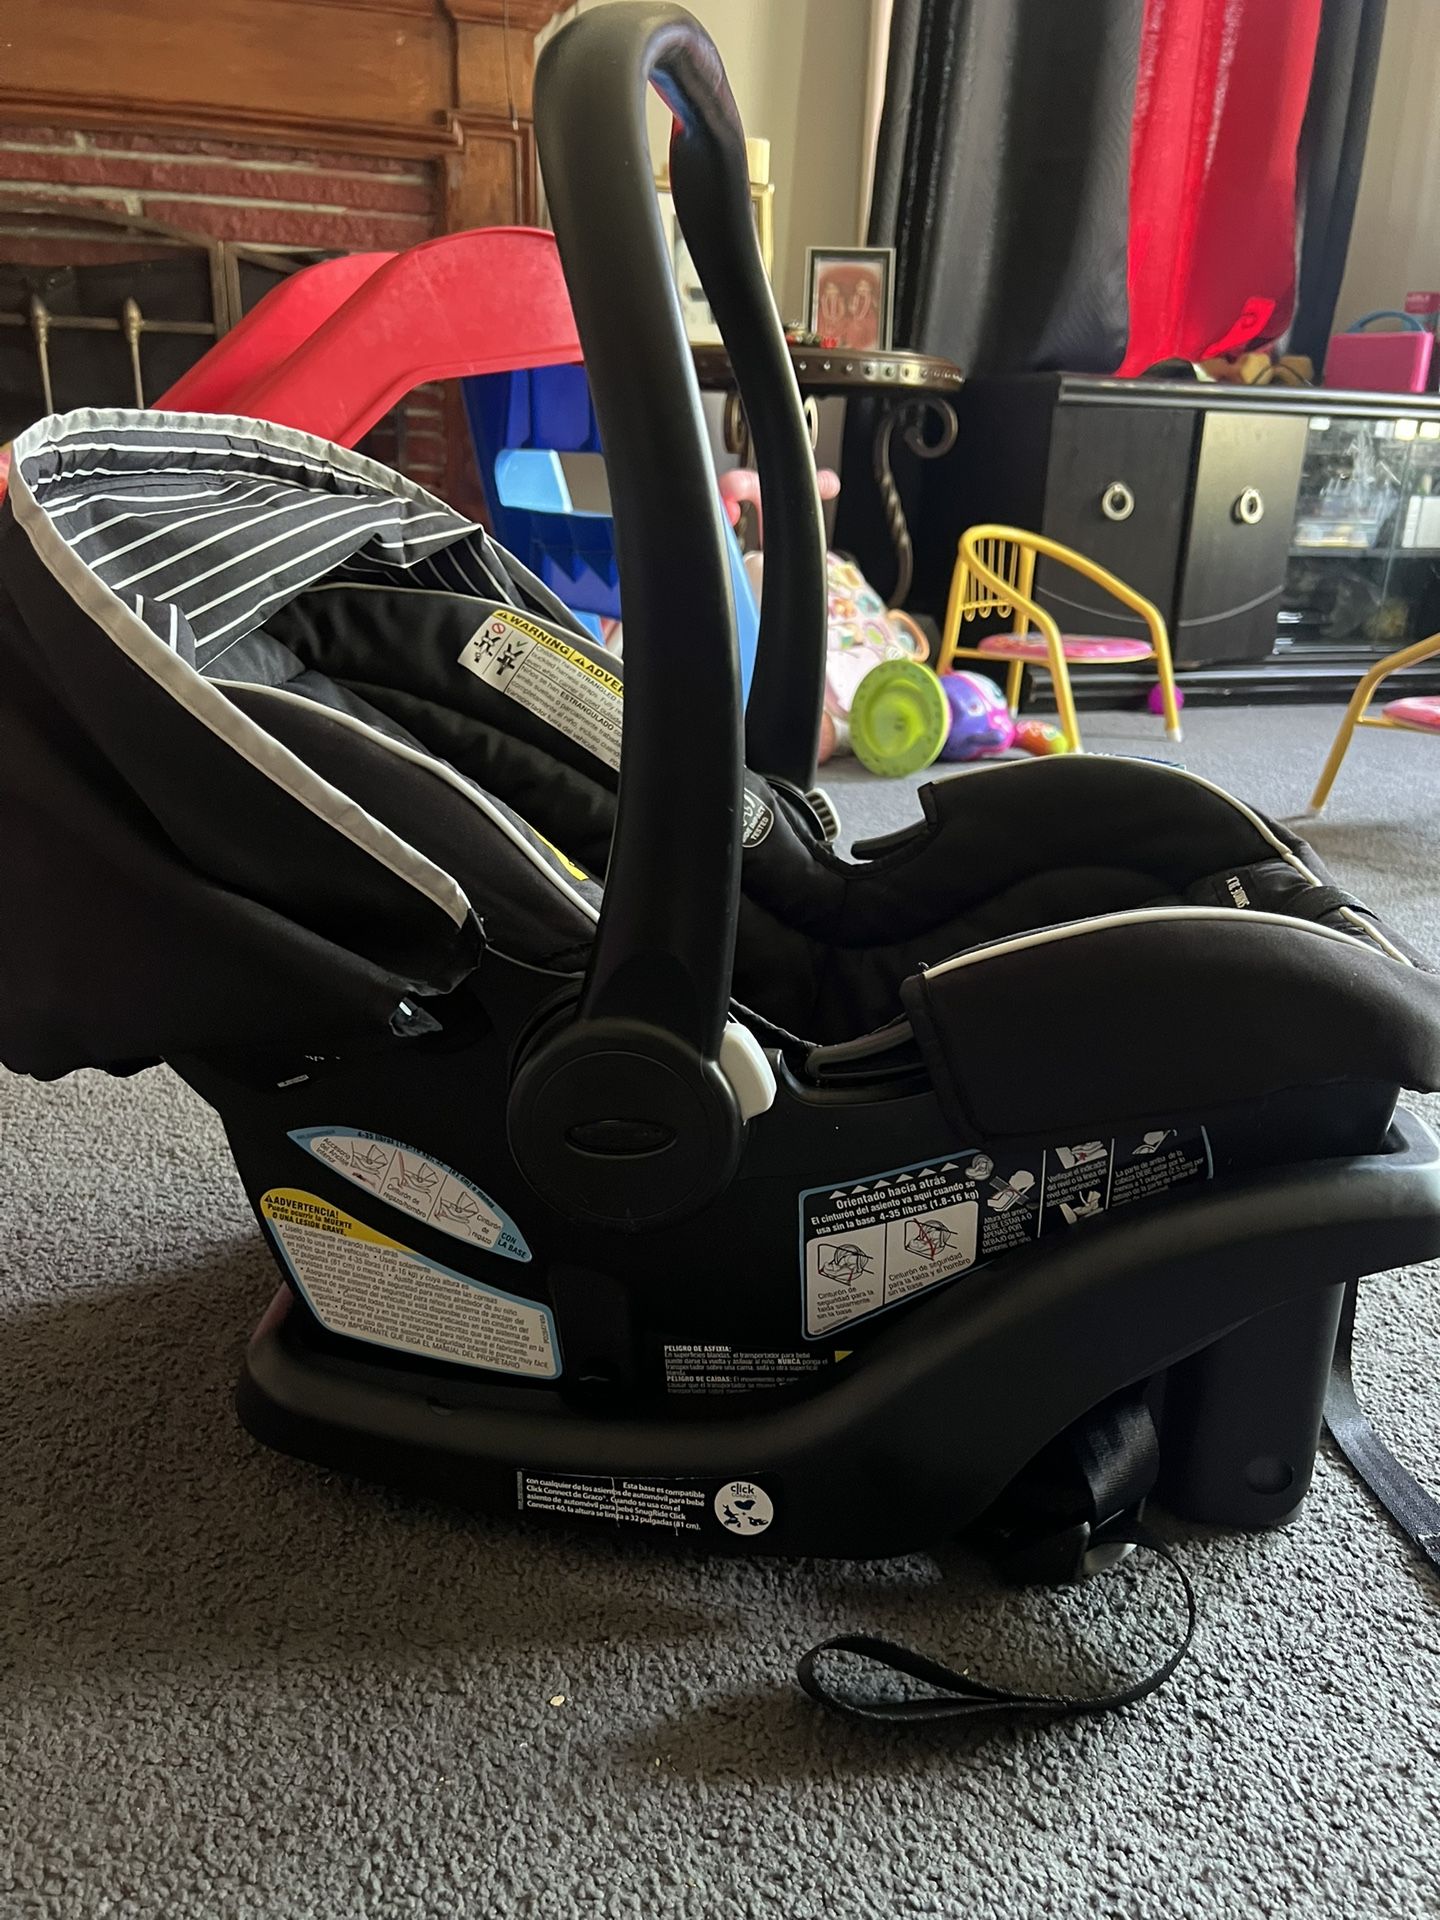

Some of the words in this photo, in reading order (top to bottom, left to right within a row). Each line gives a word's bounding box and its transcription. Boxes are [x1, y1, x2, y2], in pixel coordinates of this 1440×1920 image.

[509, 615, 570, 654] WARNING
[576, 671, 617, 701] STRANGLED
[559, 690, 614, 730] ESTRANGULADO
[750, 815, 769, 841] TESTED
[387, 1183, 411, 1200] Cinturón
[411, 1197, 420, 1205] de
[810, 1216, 819, 1225] El
[820, 1208, 854, 1223] cinturón
[855, 1204, 869, 1215] del
[869, 1197, 900, 1211] asiento
[901, 1195, 912, 1204] va
[912, 1189, 932, 1203] aquí
[932, 1181, 964, 1196] cuando
[964, 1180, 975, 1188] se
[835, 1189, 886, 1210] Orientado
[887, 1181, 916, 1197] hacia
[918, 1173, 946, 1189] atrás
[267, 1203, 288, 1213] Puede
[290, 1209, 313, 1219] ocurrir
[323, 1217, 352, 1229] MUERTE
[273, 1196, 339, 1218] ADVERTENCIA!
[279, 1214, 293, 1222] UNA
[815, 1225, 831, 1235] usa
[831, 1221, 845, 1231] sin
[845, 1219, 854, 1228] la
[855, 1214, 876, 1226] base
[878, 1208, 900, 1220] 4-35
[901, 1201, 928, 1215] libras
[928, 1192, 963, 1209] (1.8-16
[963, 1188, 979, 1201] kg)
[476, 1214, 501, 1230] Cinturón
[481, 1226, 489, 1234] de
[471, 1231, 492, 1245] regazo
[497, 1238, 507, 1248] LA
[507, 1244, 526, 1258] BASE
[500, 1231, 517, 1244] CON
[888, 1266, 917, 1281] Cinturón
[918, 1263, 927, 1271] de
[928, 1251, 963, 1269] seguridad
[888, 1280, 903, 1289] para
[912, 1271, 929, 1281] falda
[943, 1257, 970, 1271] hombro
[817, 1287, 846, 1299] Cinturón
[906, 1281, 923, 1290] base
[347, 1321, 389, 1336] IMPORTANTE
[461, 1350, 476, 1358] DEL
[476, 1353, 520, 1369] PROPIETARIO
[526, 1484, 543, 1492] Click
[543, 1486, 572, 1496] Connect
[572, 1490, 582, 1498] de
[610, 1495, 637, 1505] Cuando
[539, 1478, 571, 1490] cualquier
[632, 1491, 668, 1501] automóvil
[668, 1497, 685, 1505] para
[685, 1498, 704, 1506] bebé
[622, 1481, 638, 1489] Esta
[638, 1483, 655, 1492] base
[664, 1487, 705, 1500] compatible
[730, 1483, 754, 1494] click
[526, 1492, 551, 1501] asiento
[563, 1497, 598, 1508] automóvil
[599, 1503, 615, 1511] para
[634, 1507, 668, 1518] SnugRide
[669, 1511, 686, 1519] Click
[526, 1500, 555, 1510] Connect
[574, 1506, 595, 1515] altura
[639, 1515, 673, 1527] pulgadas
[673, 1519, 684, 1527] (81
